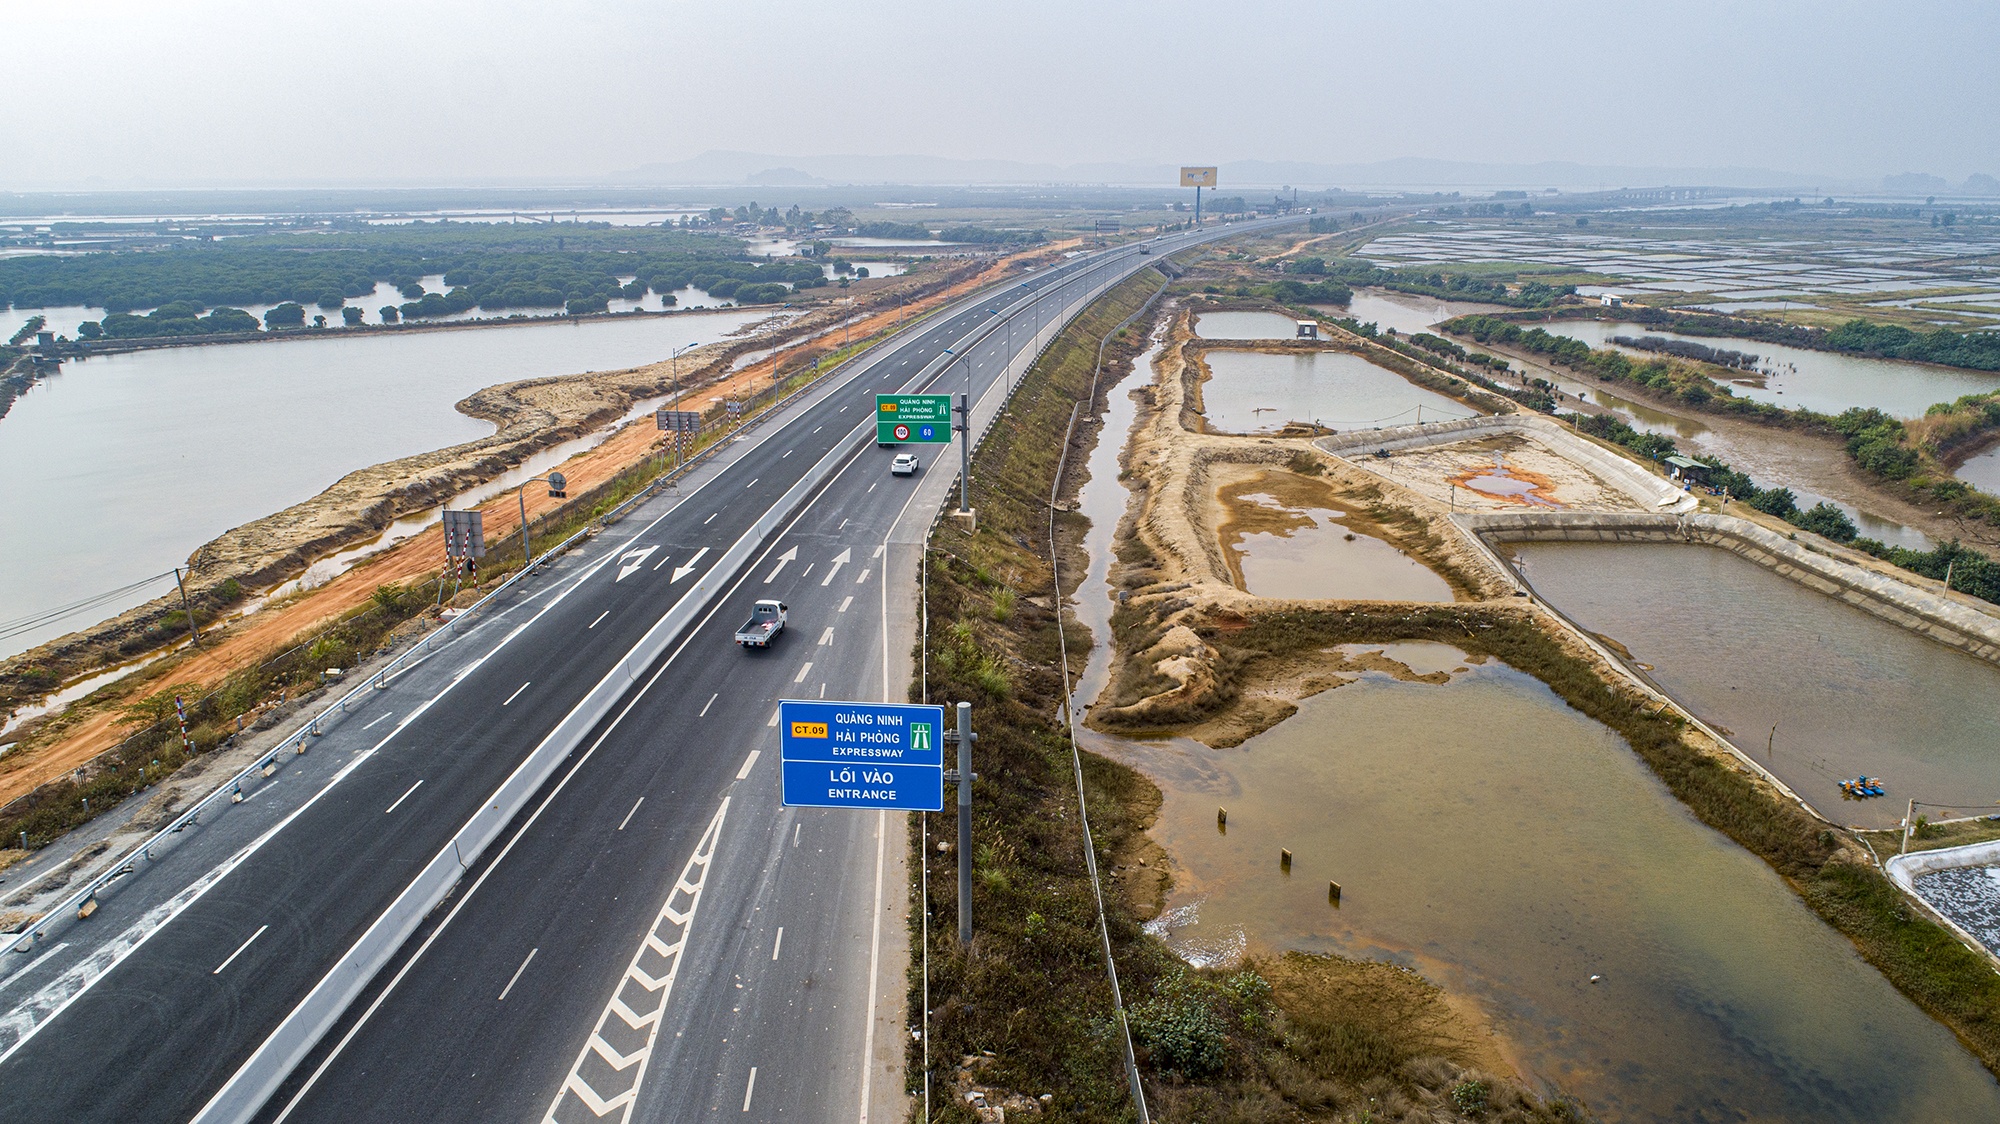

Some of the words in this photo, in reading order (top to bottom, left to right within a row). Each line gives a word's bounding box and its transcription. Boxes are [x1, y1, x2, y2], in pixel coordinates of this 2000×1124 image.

[836, 711, 872, 724] QUẢNG
[877, 715, 902, 726] NINH
[794, 726, 824, 734] CT.09
[836, 729, 855, 742] HẢI
[860, 730, 900, 743] PHÒNG
[833, 748, 904, 758] EXPRESSWAY
[830, 767, 856, 782] LỐI
[862, 768, 894, 784] VÀO
[828, 789, 896, 800] ENTRANCE
